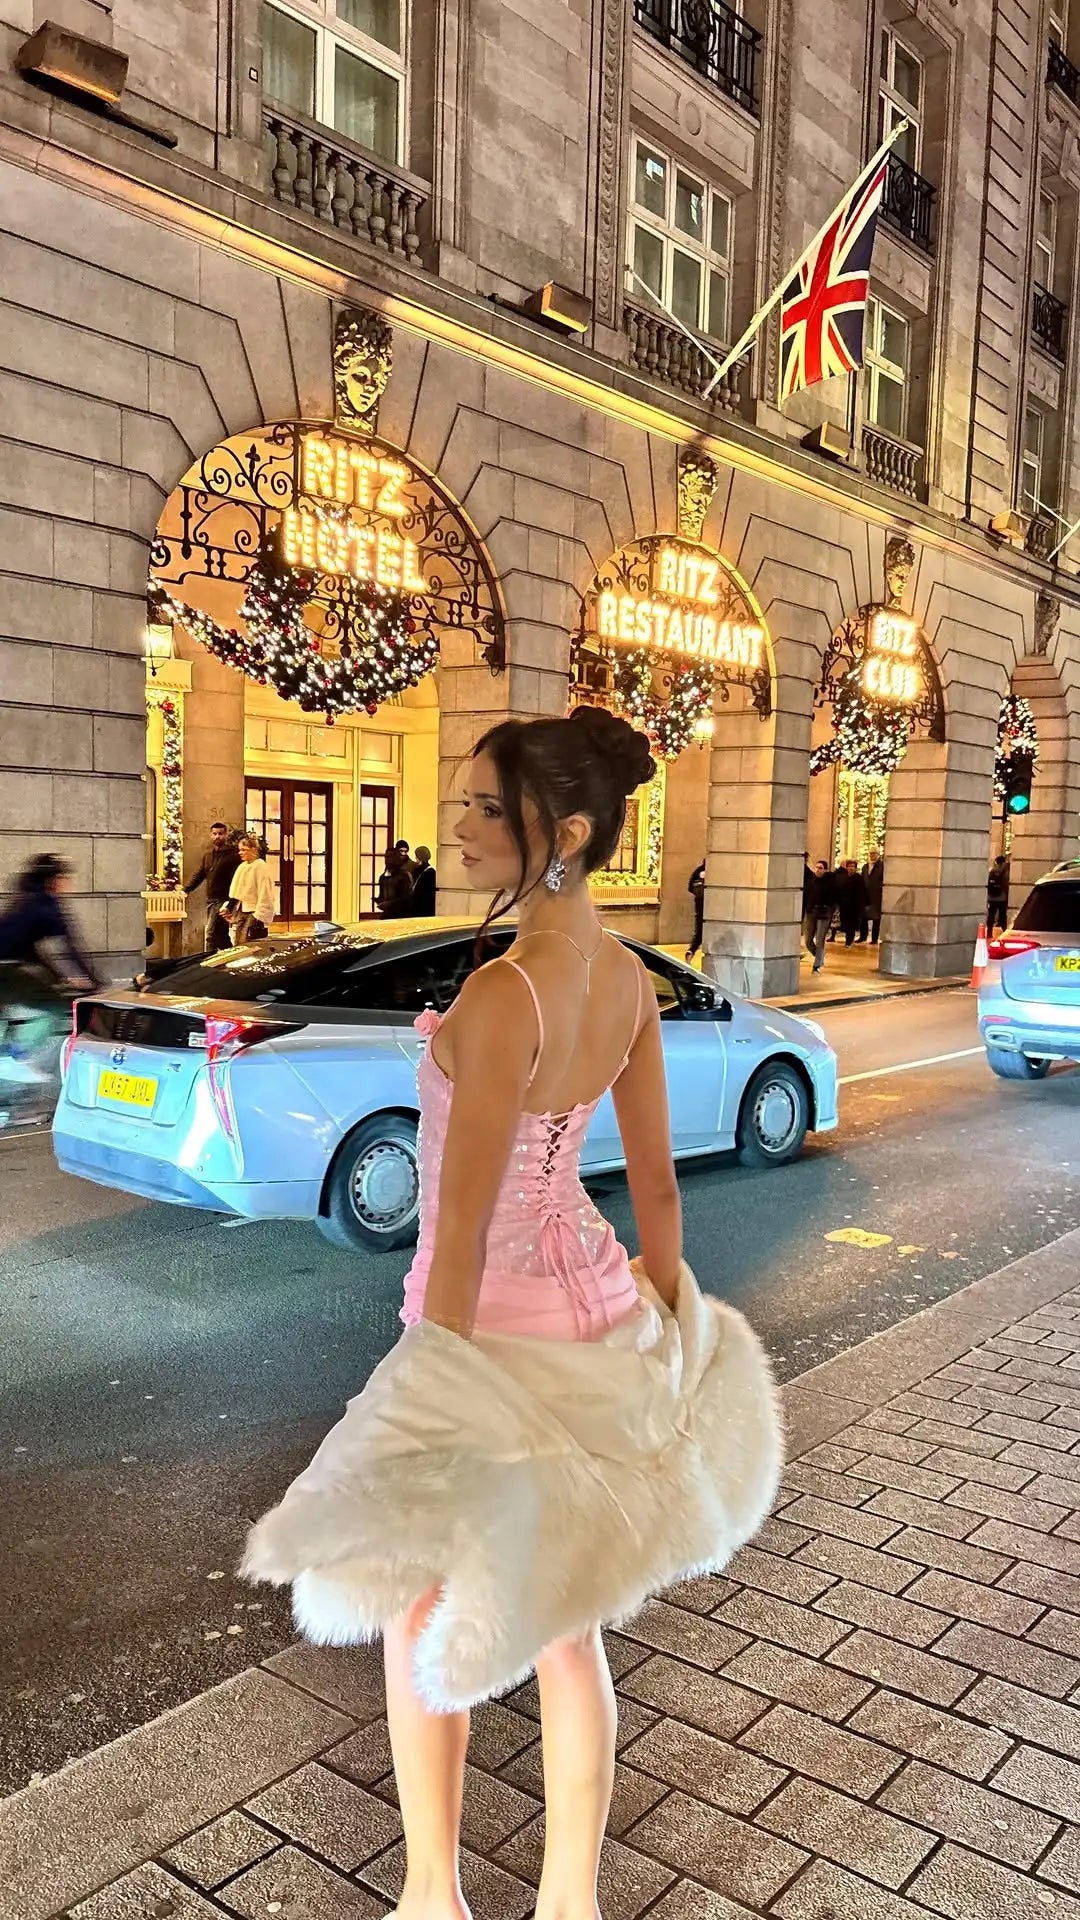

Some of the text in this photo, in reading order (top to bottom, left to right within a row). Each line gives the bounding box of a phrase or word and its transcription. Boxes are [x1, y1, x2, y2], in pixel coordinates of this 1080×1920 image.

[304, 438, 407, 517] RITZ
[284, 510, 428, 593] HOTEL
[660, 549, 719, 604] RITZ
[600, 592, 764, 668] RESTAURANT
[873, 610, 917, 656] RITZ
[864, 656, 920, 701] CLUB
